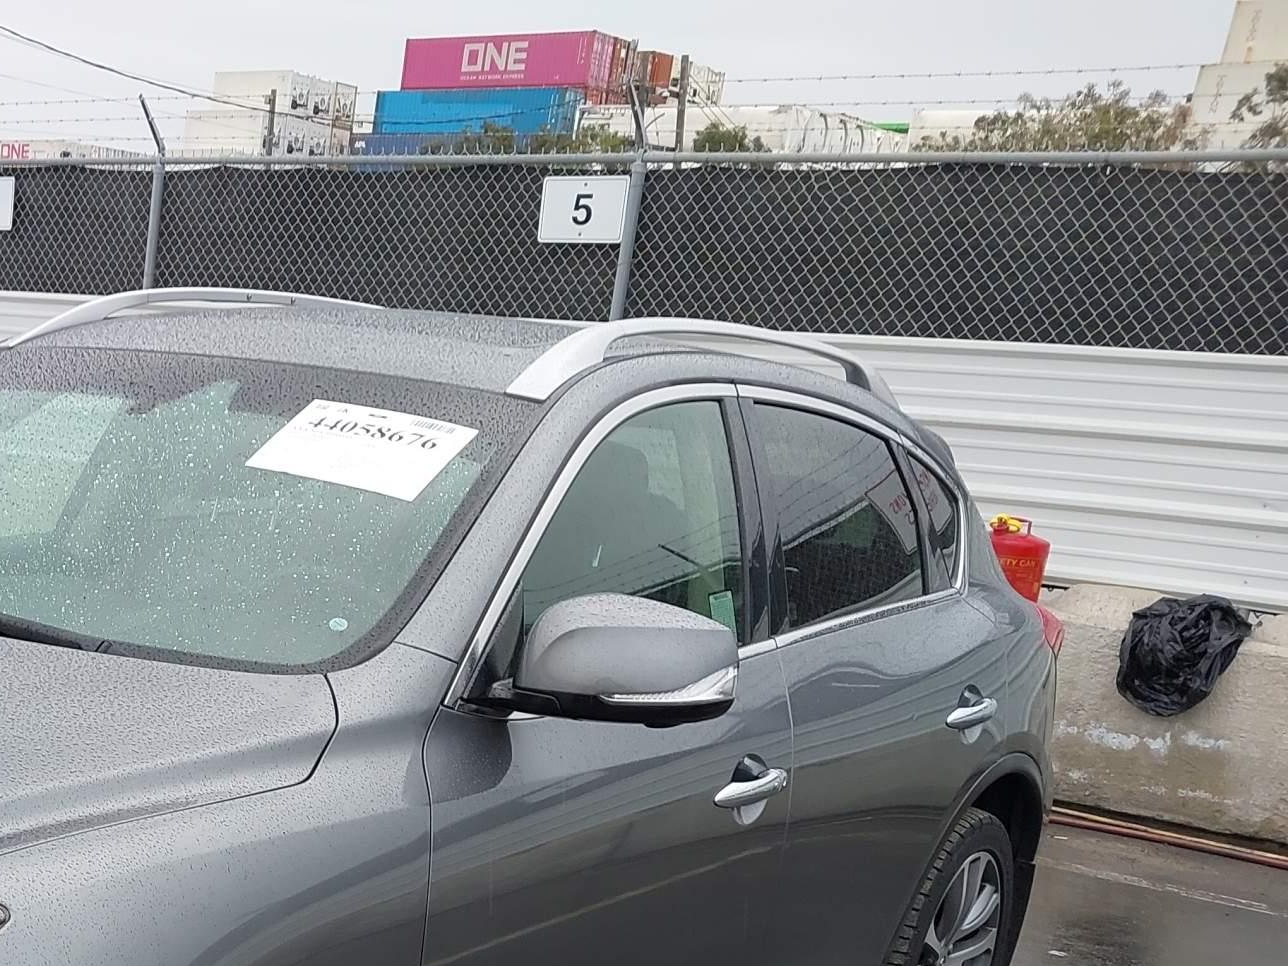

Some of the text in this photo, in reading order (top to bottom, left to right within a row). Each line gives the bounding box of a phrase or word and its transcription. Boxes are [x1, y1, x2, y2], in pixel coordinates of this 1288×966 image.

[461, 41, 529, 72] ONE
[1, 143, 30, 159] ONE
[572, 193, 593, 226] 5
[309, 416, 437, 449] 44058676
